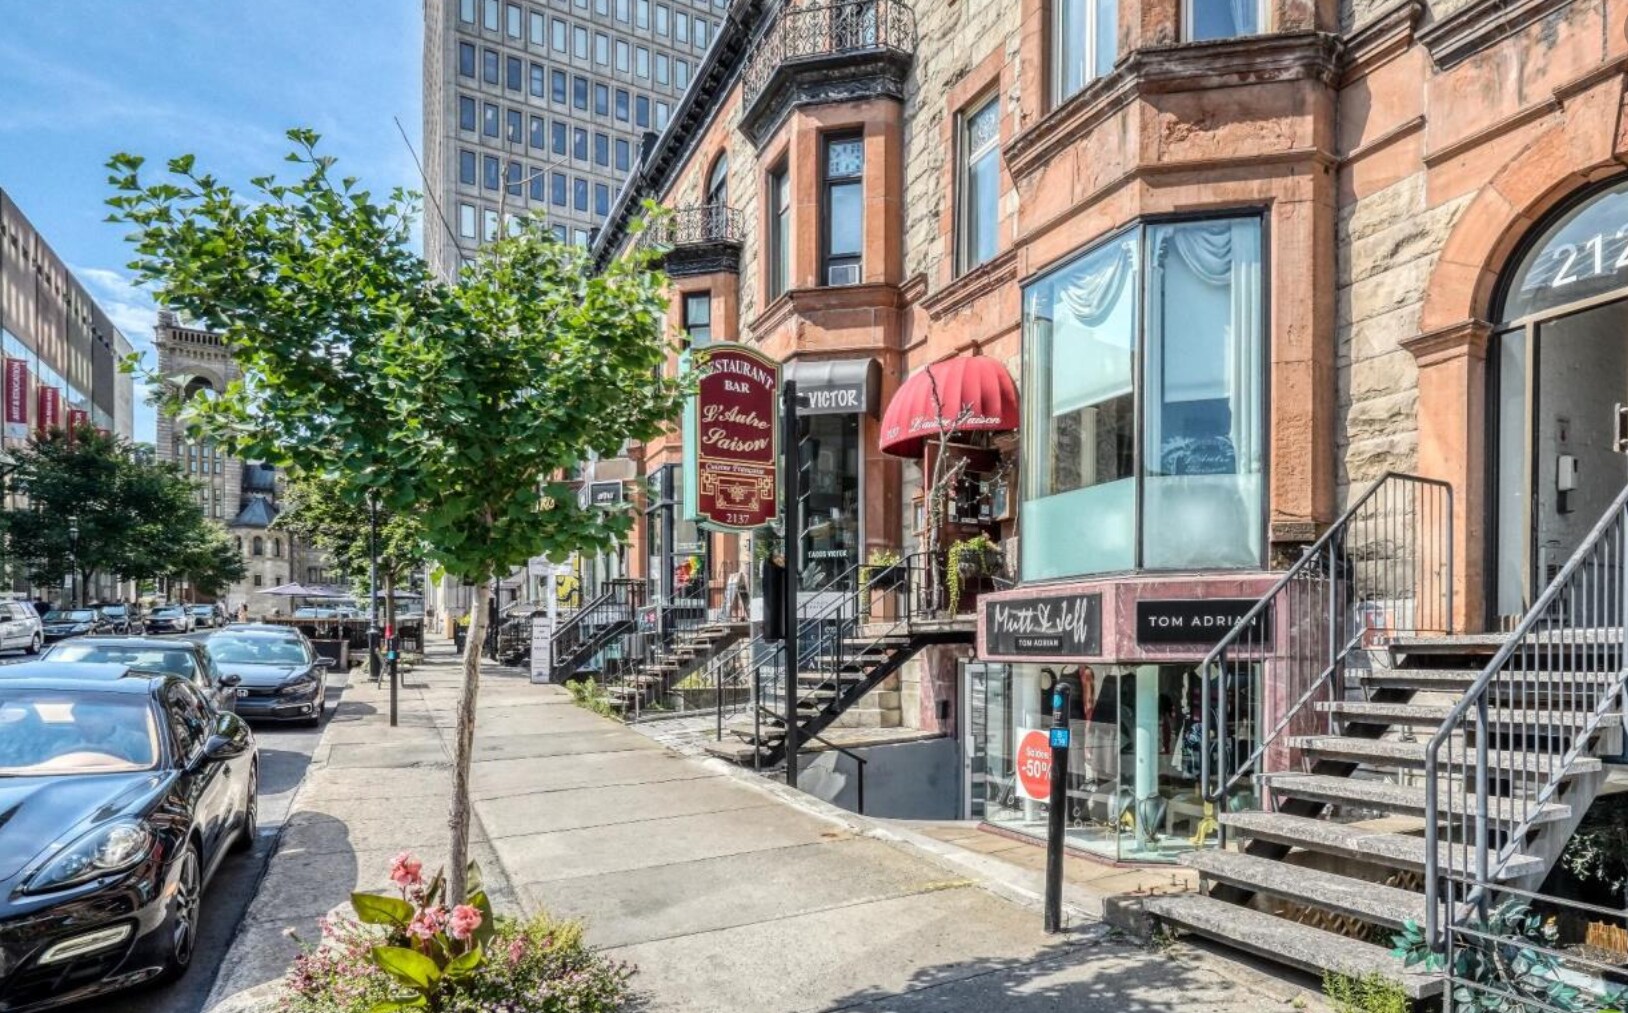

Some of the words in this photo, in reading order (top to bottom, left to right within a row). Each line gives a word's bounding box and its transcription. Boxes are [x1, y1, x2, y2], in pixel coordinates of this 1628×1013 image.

[706, 359, 774, 391] ESTAURANT
[724, 379, 751, 394] BAR
[808, 389, 859, 408] VICTOR
[702, 404, 770, 430] L'Autre
[702, 427, 769, 453] Saison
[726, 512, 750, 525] 2137
[994, 604, 1034, 633] Mutt
[1037, 603, 1053, 632] &
[1056, 598, 1088, 643] Jeff
[1147, 616, 1183, 627] TOM
[1191, 615, 1257, 627] ADRIAN
[1018, 639, 1032, 647] TOM
[1033, 639, 1059, 647] ADRIAN
